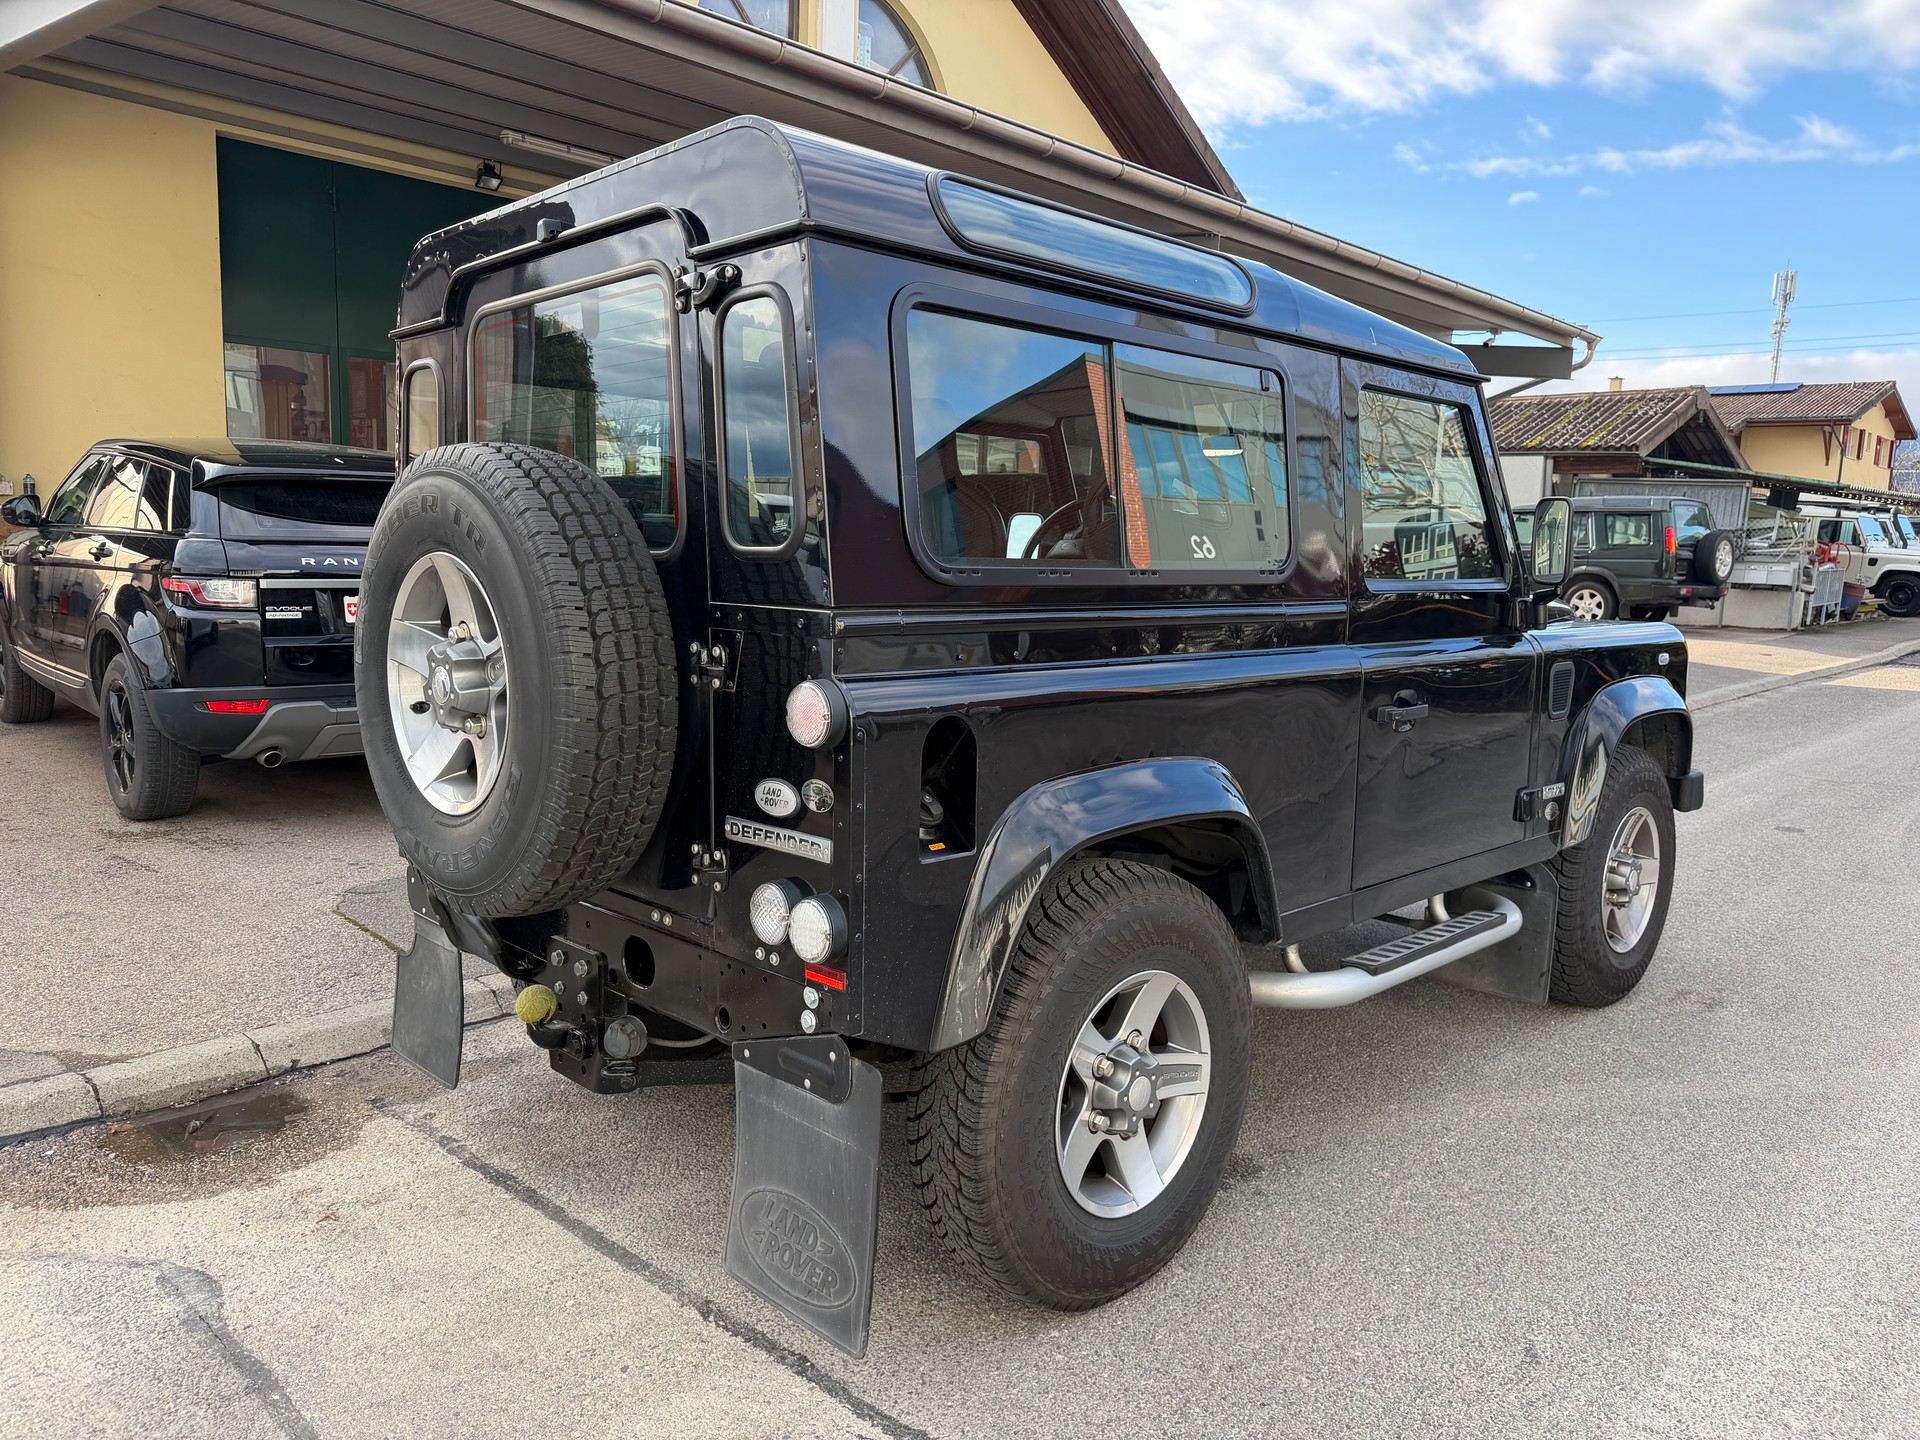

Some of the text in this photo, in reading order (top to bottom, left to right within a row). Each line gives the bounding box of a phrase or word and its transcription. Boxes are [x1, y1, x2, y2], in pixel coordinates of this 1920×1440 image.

[762, 786, 782, 798] LAND
[764, 797, 789, 809] ROVER
[730, 821, 824, 859] DEFENDER
[760, 1199, 818, 1252] LAND
[761, 1231, 838, 1299] ROVER
